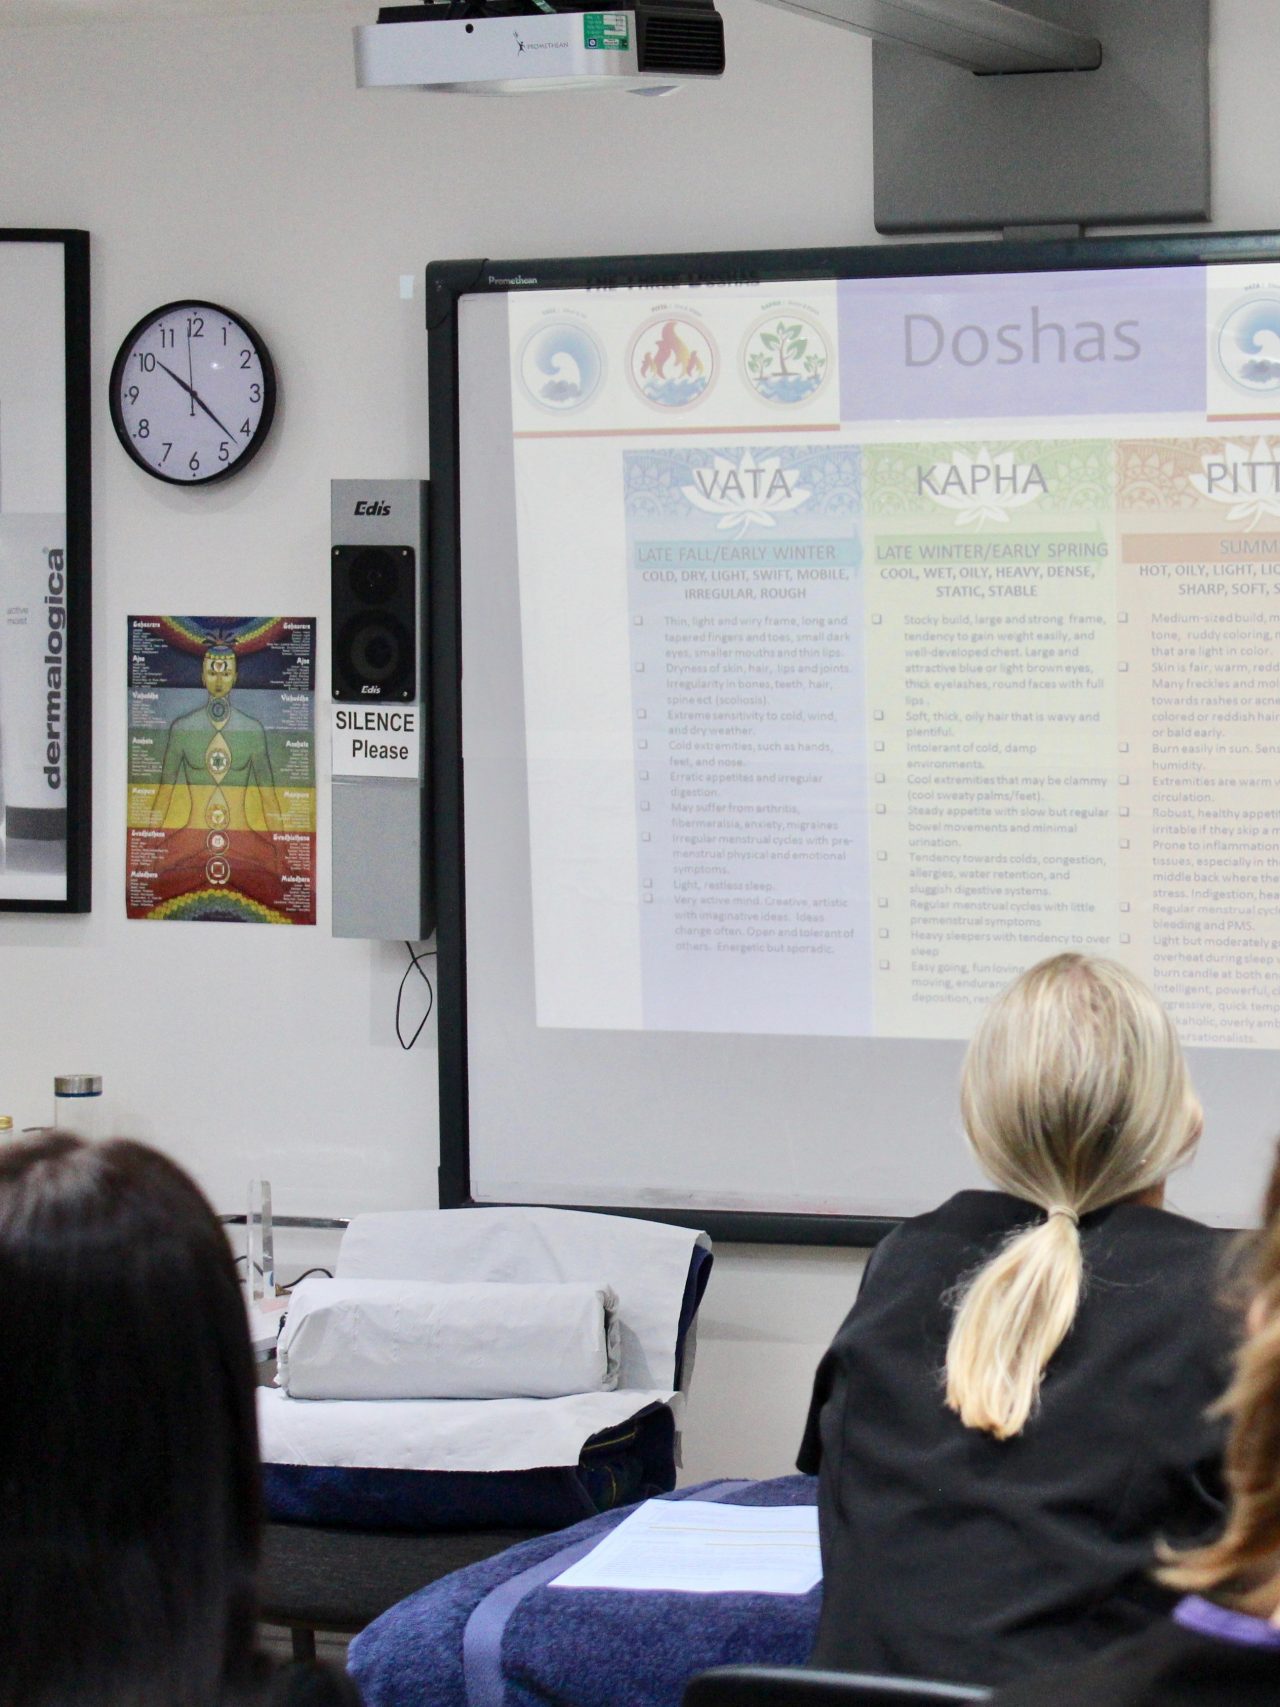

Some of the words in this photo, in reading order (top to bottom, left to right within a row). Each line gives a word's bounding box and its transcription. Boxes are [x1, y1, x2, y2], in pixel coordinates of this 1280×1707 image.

[488, 275, 538, 285] Promethean
[187, 318, 204, 337] 12
[161, 329, 174, 347] 11
[223, 328, 227, 346] 1
[903, 307, 1140, 367] Doshas
[139, 353, 155, 372] 10
[240, 350, 251, 369] 2
[129, 386, 139, 405] 9
[250, 384, 261, 402] 3
[139, 419, 149, 438] 8
[240, 418, 251, 437] 4
[162, 443, 172, 462] 7
[219, 442, 229, 461] 5
[189, 452, 199, 470] 6
[697, 469, 792, 499] VATA
[917, 463, 1048, 496] KAPHA
[354, 501, 391, 516] Edis
[638, 548, 672, 561] LATE
[679, 546, 767, 563] FALL/EARLY
[773, 545, 835, 560] WINTER
[877, 546, 912, 560] LATE
[920, 544, 1040, 561] WINTER/EARLY
[1048, 542, 1108, 558] SPRING
[642, 571, 677, 583] COLD,
[681, 571, 707, 582] DRY,
[711, 570, 749, 582] LIGHT,
[753, 570, 793, 581] SWIFT,
[797, 569, 849, 581] MOBILE,
[880, 568, 919, 581] COOL,
[924, 568, 956, 580] WET,
[960, 567, 992, 580] OILY,
[996, 567, 1043, 579] HEAVY,
[1047, 566, 1095, 579] DENSE,
[1139, 565, 1171, 578] HOT,
[1175, 565, 1209, 577] OILY,
[1213, 565, 1256, 577] LIGHT,
[685, 588, 757, 600] IRREGULAR,
[761, 588, 806, 599] ROUGH
[937, 586, 985, 599] STATIC,
[989, 586, 1037, 597] STABLE
[1178, 584, 1227, 597] SHARP,
[1232, 584, 1270, 596] SOFT,
[904, 615, 938, 626] Stocky
[942, 615, 972, 626] build,
[975, 615, 1001, 626] large
[1005, 615, 1026, 624] and
[1027, 616, 1063, 626] strong
[1069, 615, 1106, 626] frame,
[1151, 613, 1232, 622] Medium-sized
[1235, 613, 1267, 624] build,
[905, 632, 954, 643] tendency
[971, 632, 994, 643] gain
[998, 632, 1033, 642] weight
[1036, 631, 1071, 643] easily,
[1074, 631, 1094, 640] and
[1151, 647, 1174, 656] that
[1178, 648, 1196, 656] are
[1199, 647, 1224, 658] light
[1227, 647, 1237, 656] in
[1241, 646, 1272, 656] color.
[44, 548, 66, 790] dermalogica
[905, 664, 956, 673] attractive
[959, 664, 983, 673] blue
[1000, 664, 1023, 674] light
[1027, 663, 1063, 673] brown
[1065, 666, 1094, 675] eyes,
[361, 685, 381, 695] Edis
[336, 711, 415, 732] SILENCE
[352, 739, 409, 760] Please
[1152, 777, 1215, 786] Extremities
[1152, 842, 1186, 850] Prone
[1189, 842, 1200, 850] to
[1203, 841, 1280, 851] inflammation
[1153, 873, 1191, 882] middle
[1194, 873, 1219, 882] back
[1223, 874, 1258, 883] where
